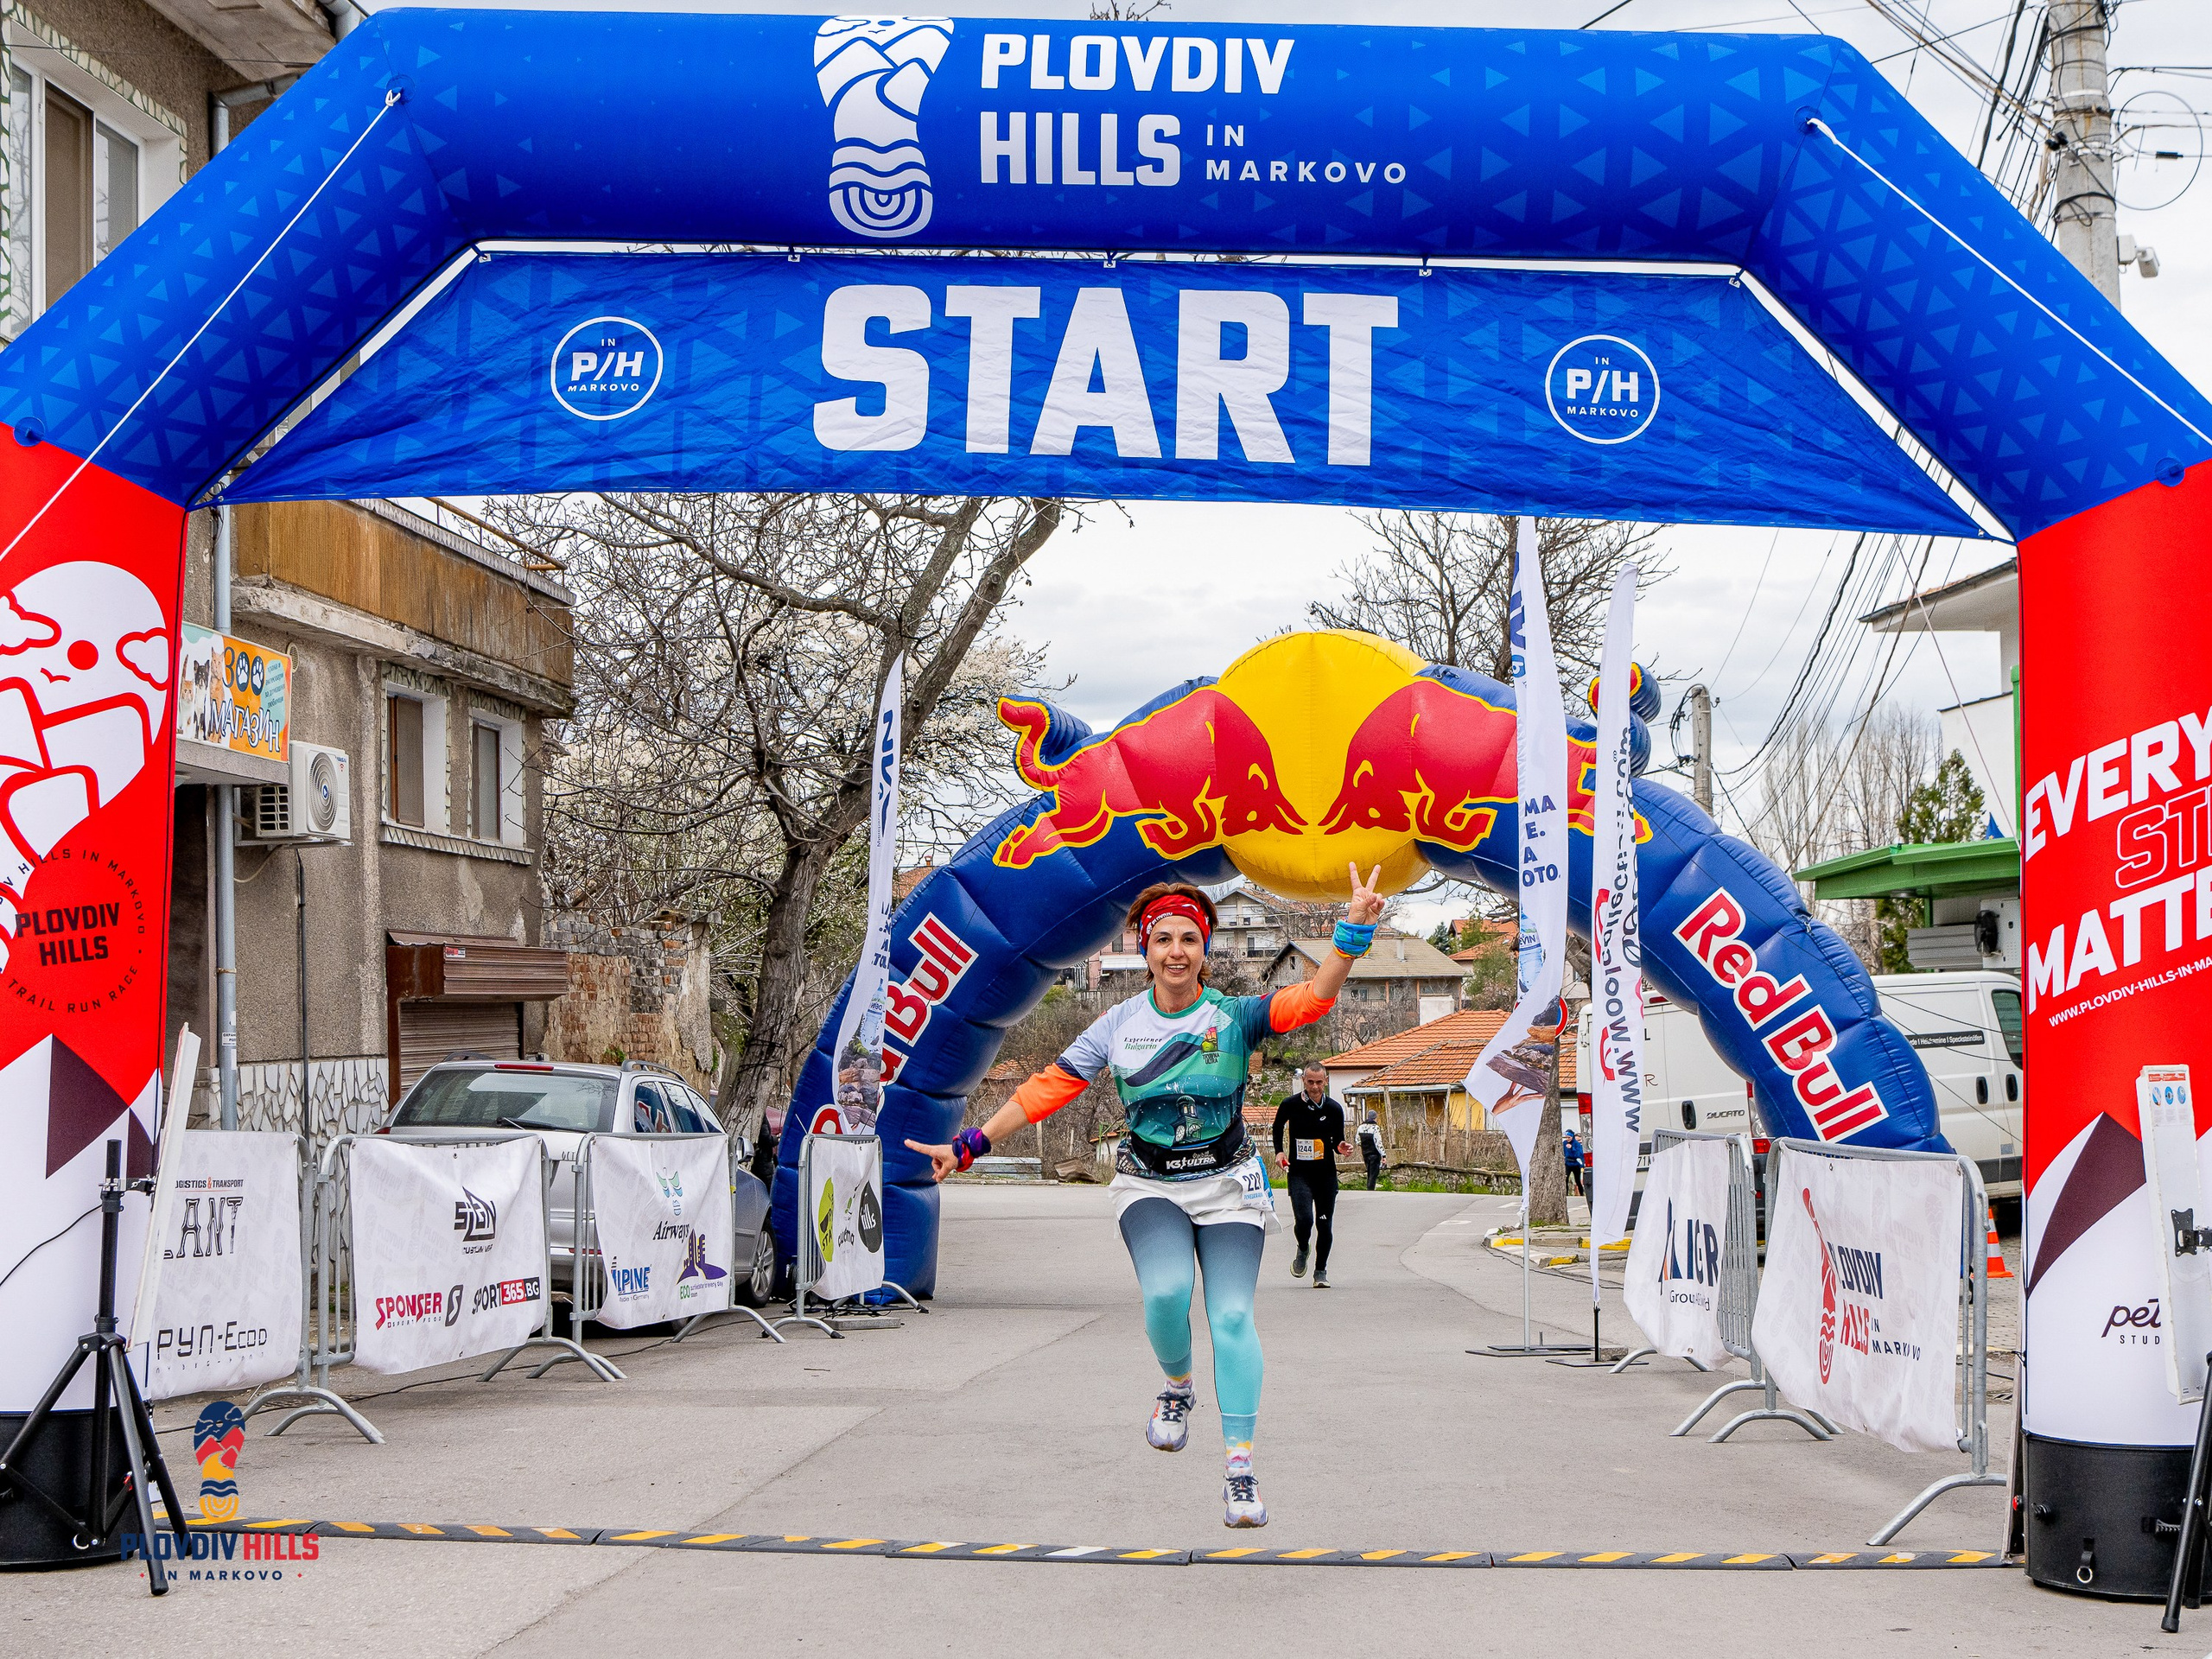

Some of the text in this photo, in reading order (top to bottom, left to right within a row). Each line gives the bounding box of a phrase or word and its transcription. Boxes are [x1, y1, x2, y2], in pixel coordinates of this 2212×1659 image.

[981, 33, 1295, 94] PLOVDIV
[981, 111, 1181, 187] HILLS
[1206, 124, 1244, 148] IN
[1205, 159, 1407, 184] MARKOVO
[601, 338, 616, 346] IN
[570, 351, 645, 382] P/H
[812, 284, 1399, 467] START
[1594, 356, 1610, 365] IN
[567, 383, 640, 392] MARKOVO
[1567, 368, 1639, 404] P/H
[1567, 406, 1639, 418] MARKOVO
[210, 698, 281, 753] МАГАЗИН
[2025, 705, 2212, 862] EVERY
[2115, 784, 2212, 889] ST
[82, 849, 100, 862] IN
[15, 902, 120, 938] PLOVDIV
[39, 936, 109, 967] HILLS
[8, 965, 138, 1014] TRAIL RUN RACE
[883, 916, 976, 1043] Bull
[1678, 890, 1885, 1142] Red Bull
[1124, 1043, 1157, 1052] Bulgaria
[1707, 1109, 1745, 1120] DUCATO
[652, 1220, 690, 1244] Airways
[680, 1284, 690, 1300] ECO
[375, 1292, 442, 1331] SPONSER
[1871, 1317, 1880, 1332] IN
[1840, 1299, 1870, 1356] HILLS
[2120, 1335, 2160, 1344] STUD
